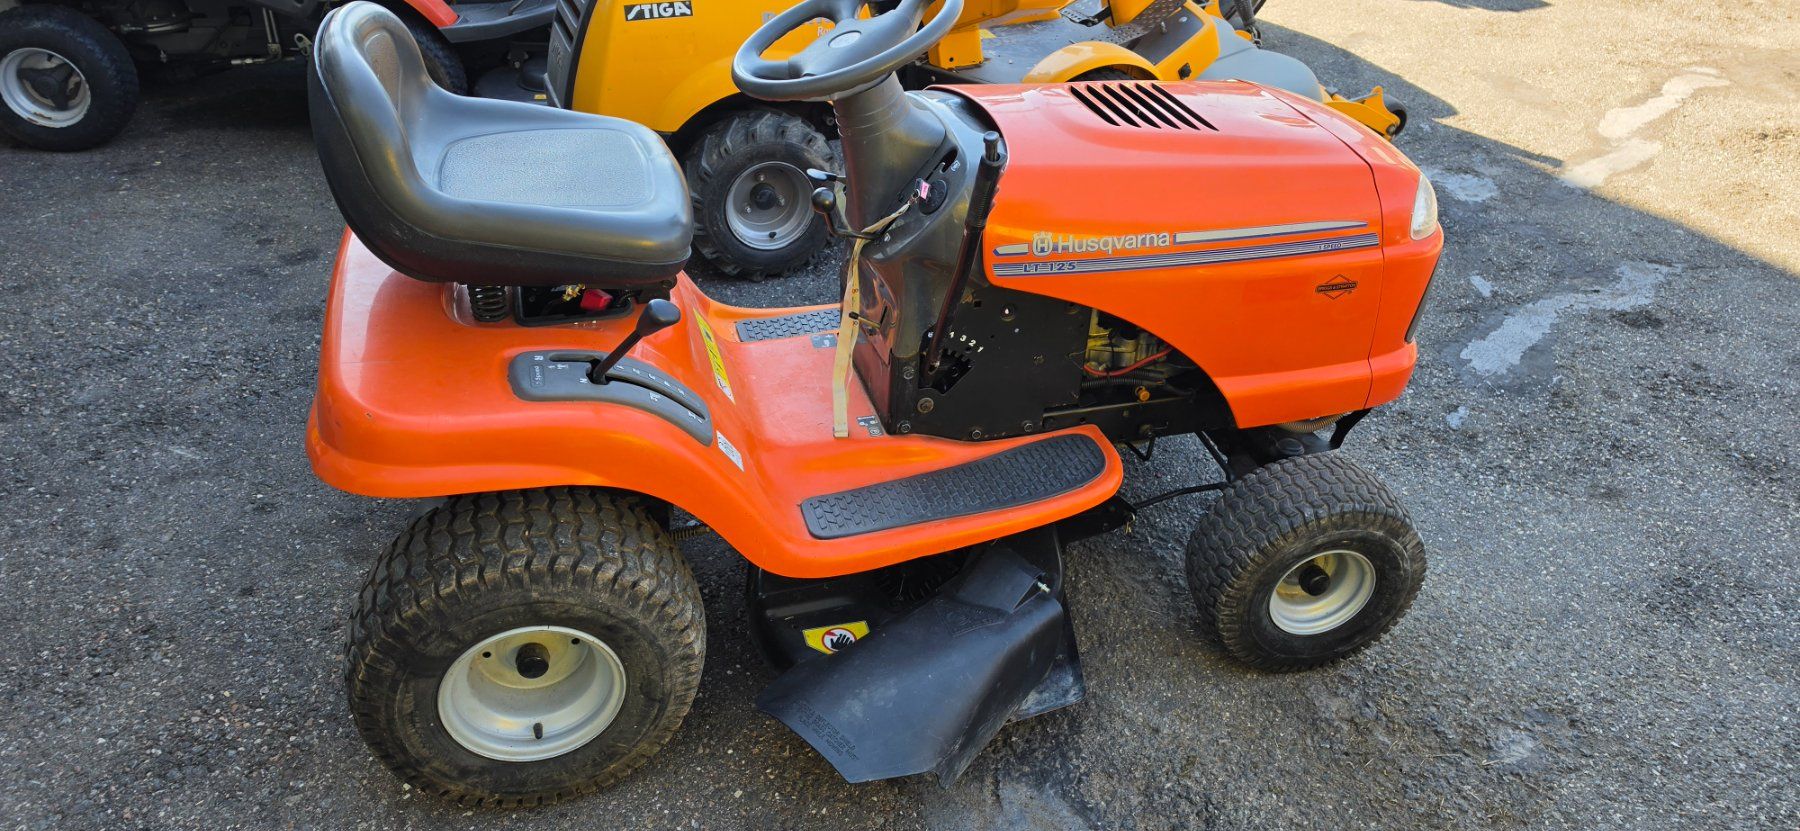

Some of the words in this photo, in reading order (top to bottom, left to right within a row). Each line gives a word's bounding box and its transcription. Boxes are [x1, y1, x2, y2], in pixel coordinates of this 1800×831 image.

[627, 2, 691, 20] STIGA
[1058, 232, 1170, 254] Husqvarna
[1023, 263, 1040, 272] LT
[1049, 262, 1076, 271] 125
[960, 334, 967, 342] 3
[968, 339, 976, 347] 2
